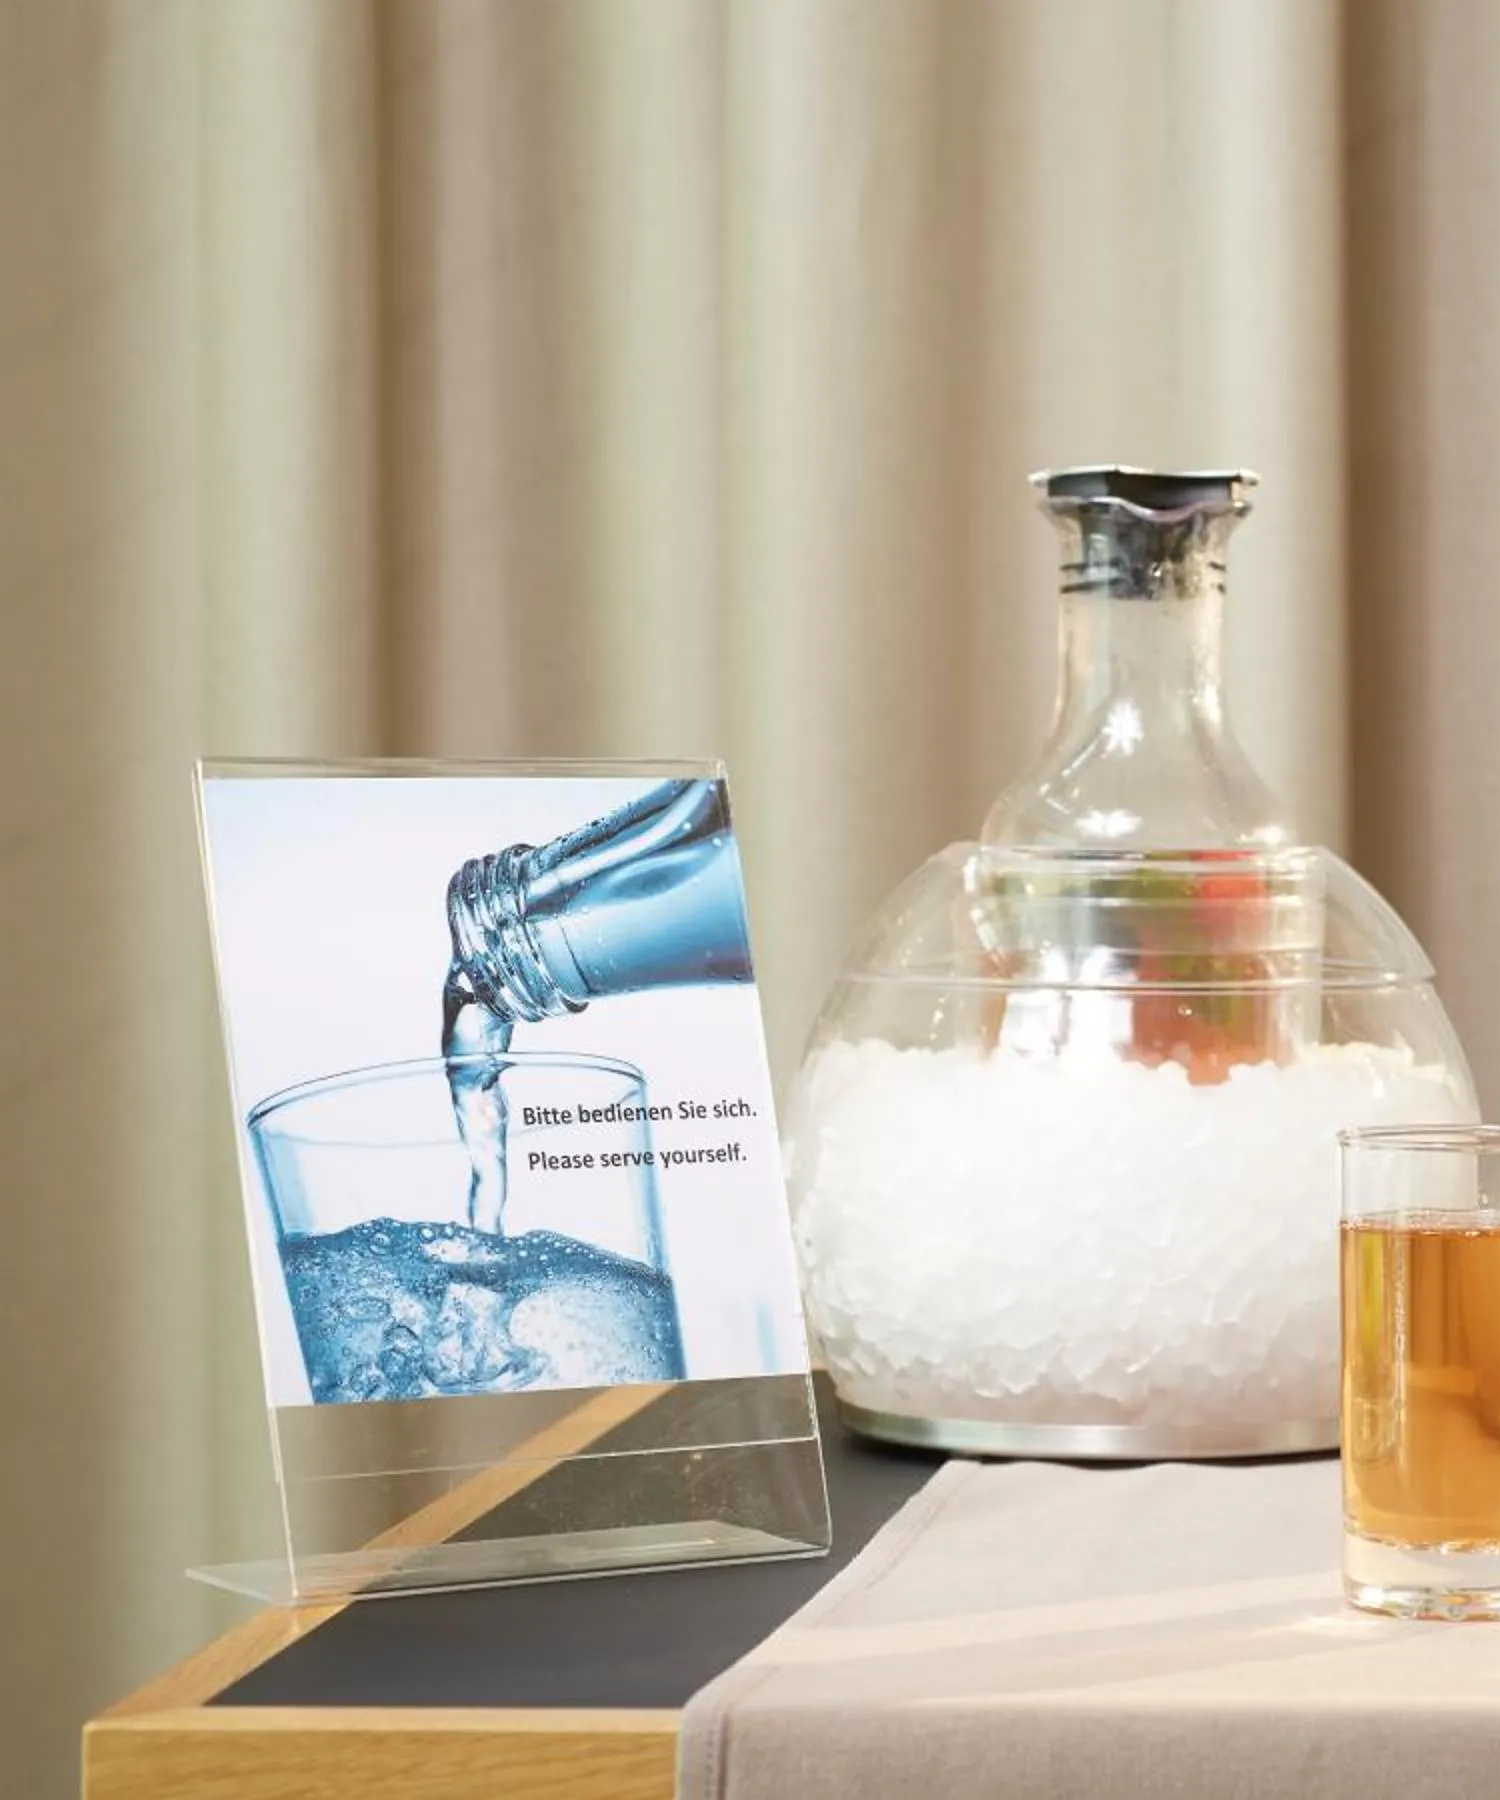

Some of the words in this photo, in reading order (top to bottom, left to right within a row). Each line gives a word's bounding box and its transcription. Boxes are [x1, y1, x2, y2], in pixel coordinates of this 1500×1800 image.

[523, 1106, 572, 1126] Bitte
[578, 1103, 672, 1123] bedienen
[679, 1100, 707, 1119] Sie
[713, 1097, 757, 1117] sich.
[528, 1151, 595, 1171] Please
[600, 1152, 654, 1167] serve
[660, 1143, 747, 1168] yourself.
